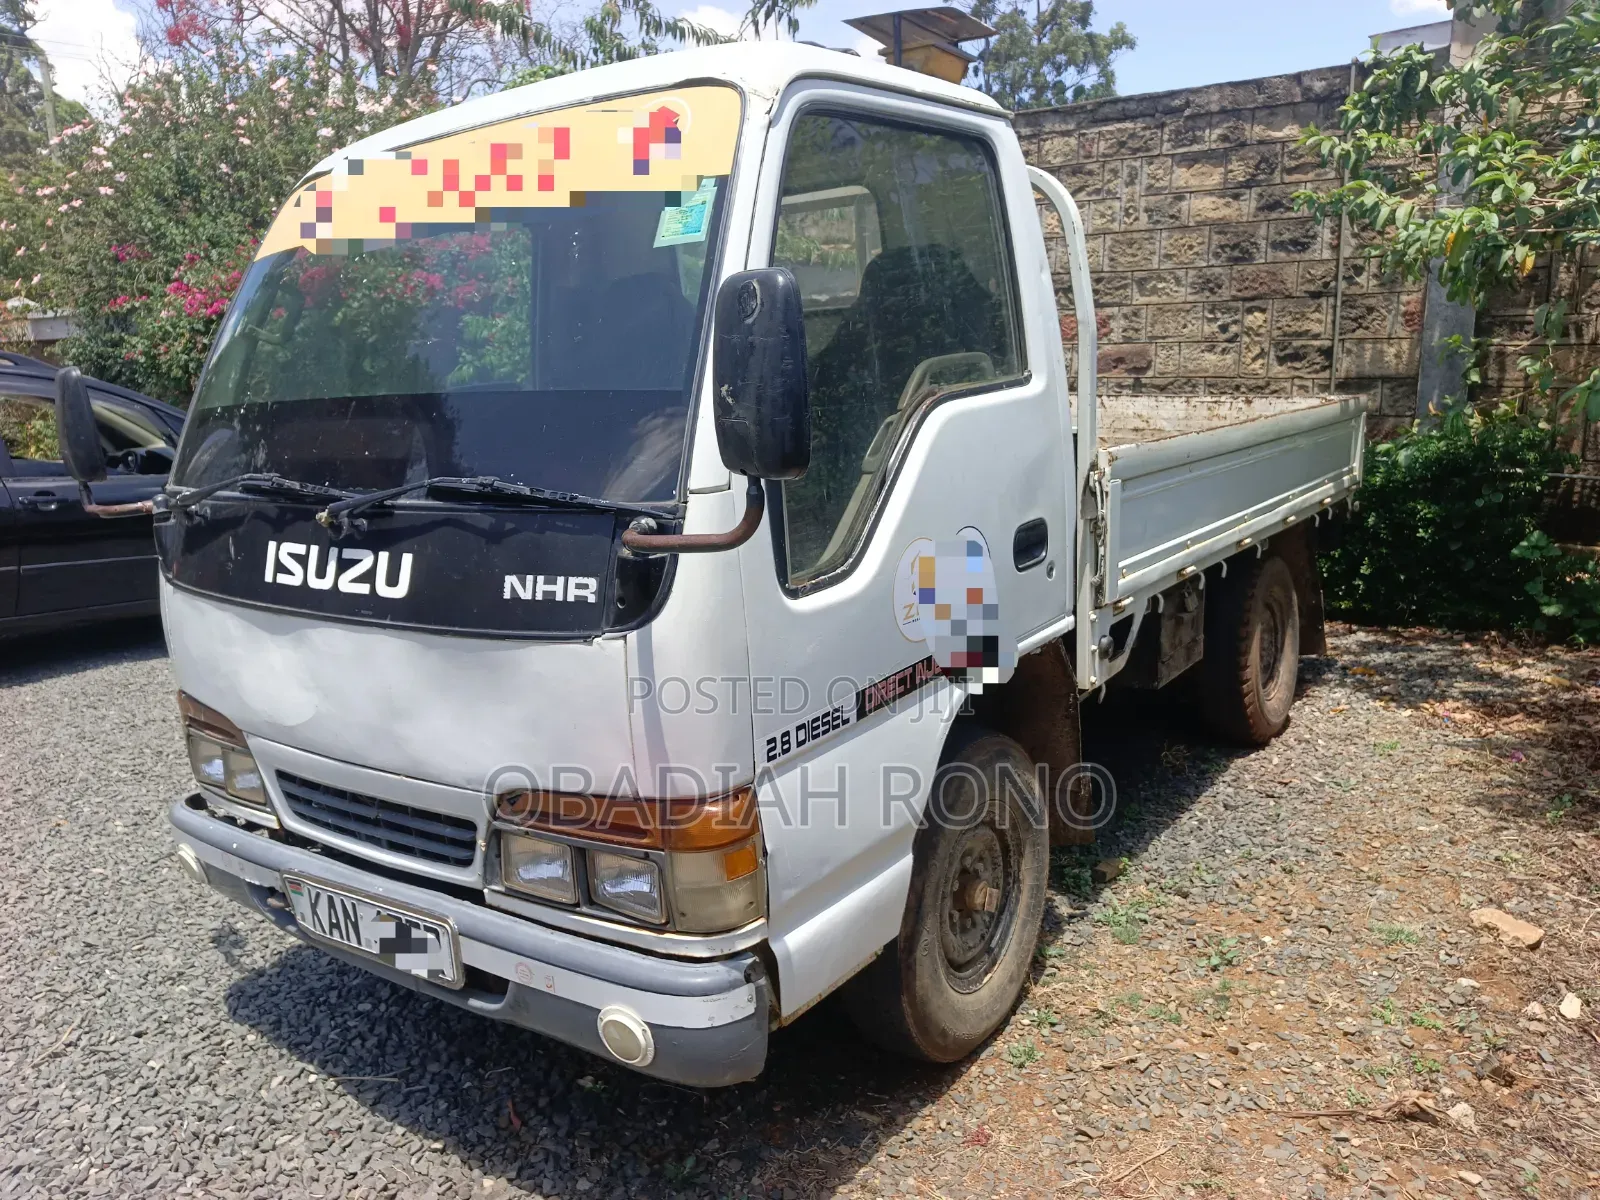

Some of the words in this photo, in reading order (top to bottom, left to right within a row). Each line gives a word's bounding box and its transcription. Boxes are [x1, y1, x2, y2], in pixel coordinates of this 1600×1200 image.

[264, 540, 413, 599] ISUZU
[503, 574, 597, 603] NHR
[766, 730, 792, 763] 2.8
[795, 704, 850, 748] DIESEL
[864, 666, 913, 711] DIRECT
[307, 885, 362, 947] KAN
